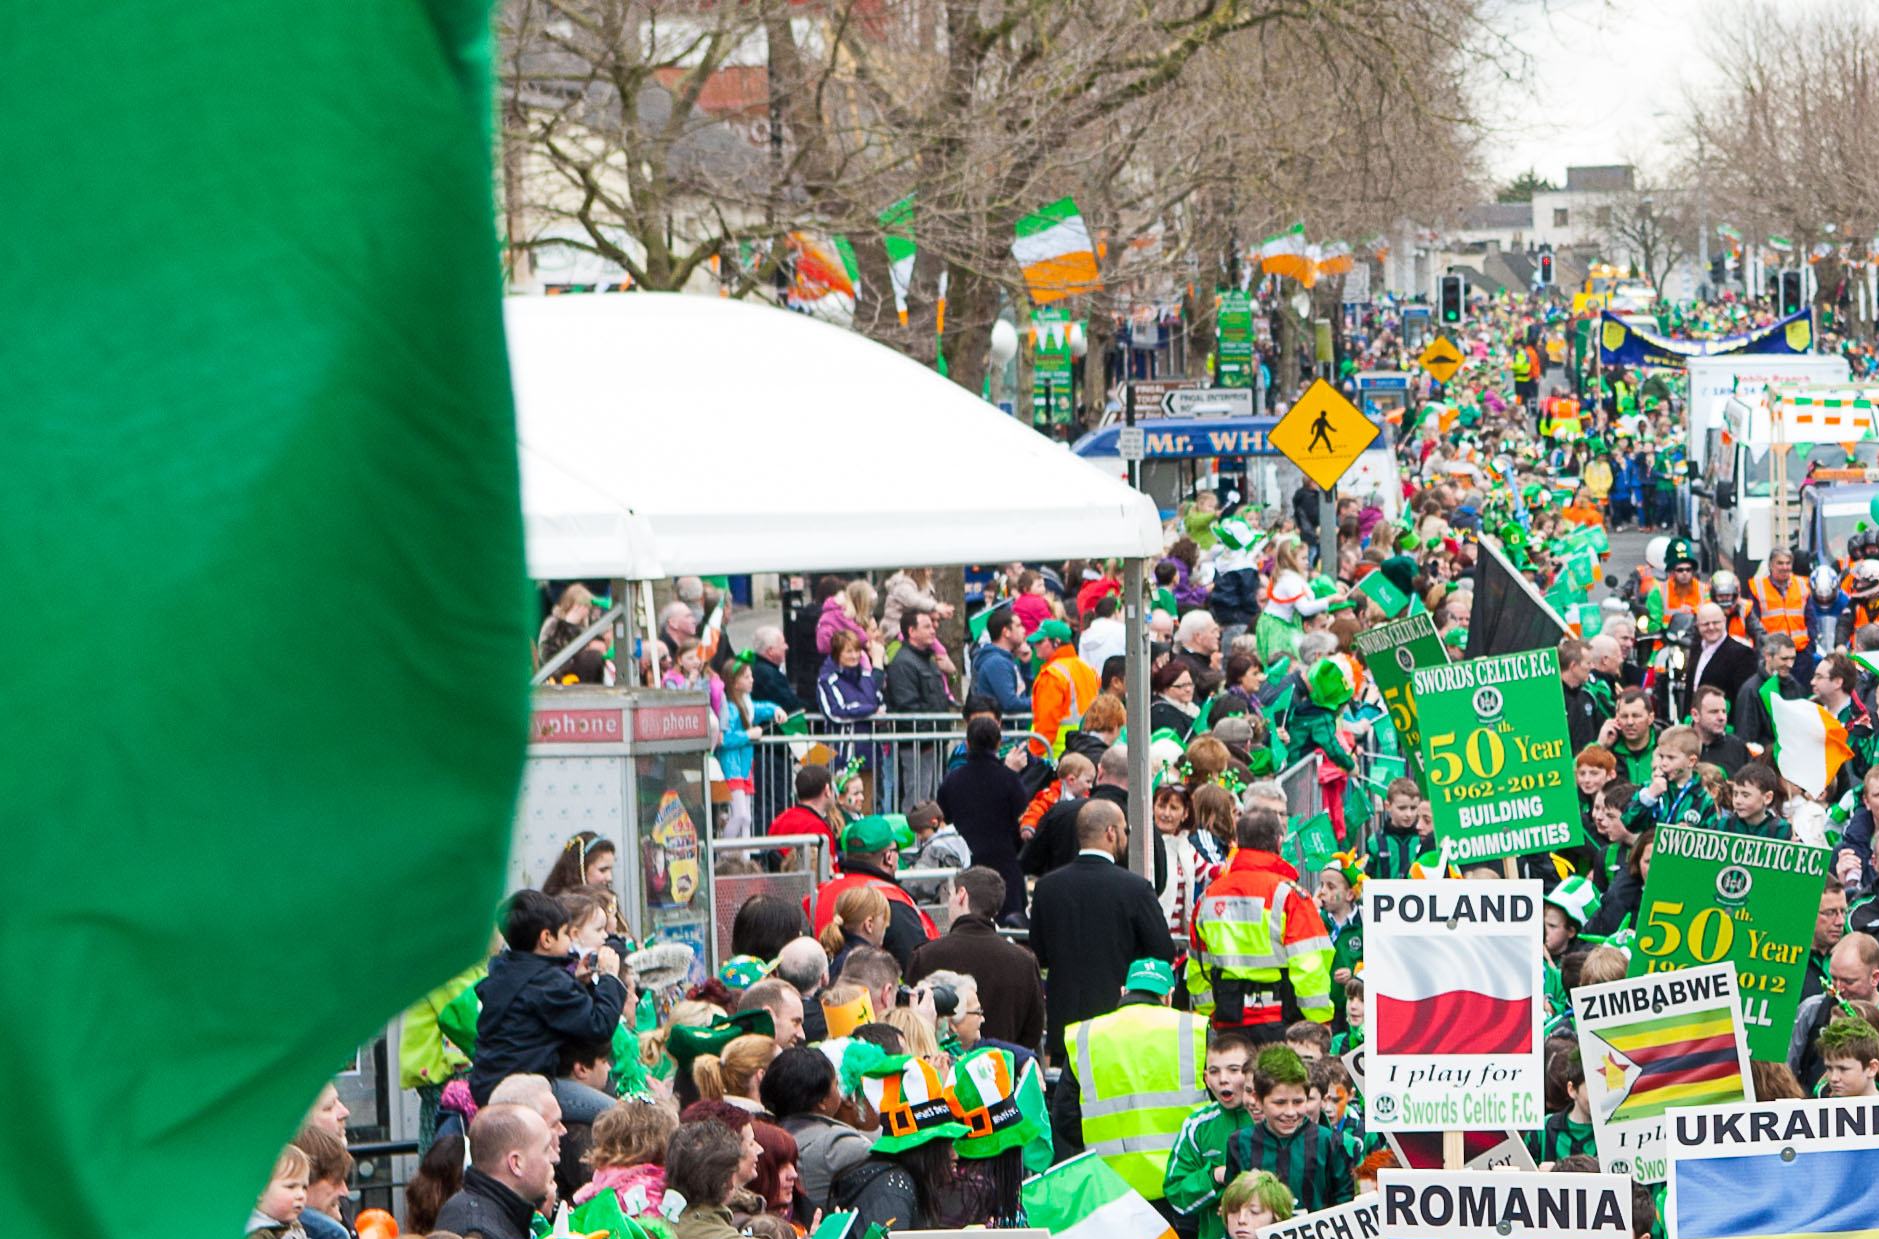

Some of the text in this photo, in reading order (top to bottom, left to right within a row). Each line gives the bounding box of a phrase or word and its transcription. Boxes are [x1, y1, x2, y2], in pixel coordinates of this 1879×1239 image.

[1145, 432, 1194, 454] Mr.
[1414, 651, 1557, 696] SWORDS CELTIC F.C.
[1429, 725, 1565, 787] 50 Year
[1443, 770, 1562, 804] 1962 2012
[1459, 796, 1545, 830] BUILDING
[1446, 822, 1572, 861] COMMUNITIES
[1656, 829, 1825, 877] SWORDS CELTIC F.C.
[1373, 894, 1534, 924] POLAND
[1639, 900, 1804, 966] 50 Year
[1581, 972, 1731, 1021] ZIMBABWE
[1389, 1063, 1522, 1088] I play for
[1402, 1091, 1538, 1124] Swords Celtic F.C.
[1386, 1185, 1626, 1232] ROMANIA
